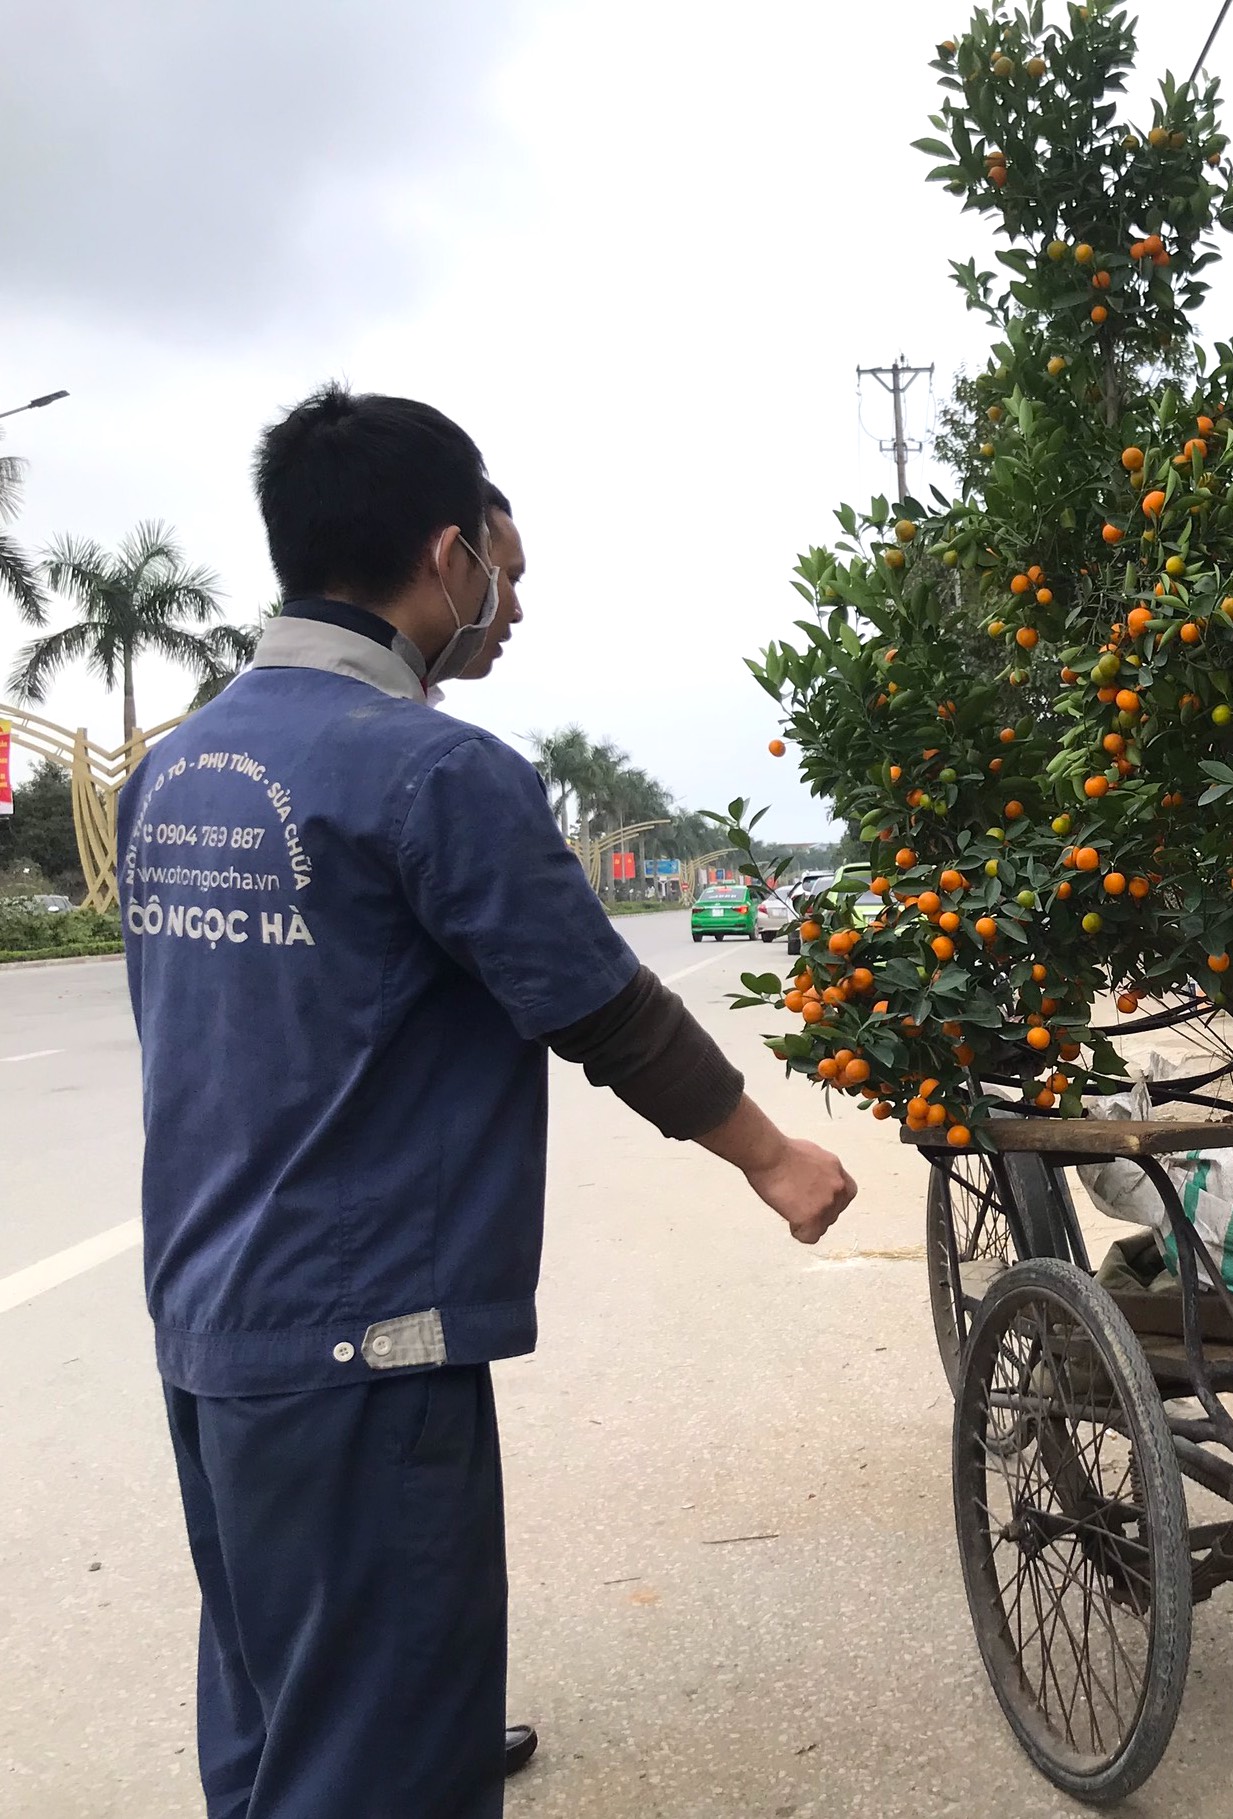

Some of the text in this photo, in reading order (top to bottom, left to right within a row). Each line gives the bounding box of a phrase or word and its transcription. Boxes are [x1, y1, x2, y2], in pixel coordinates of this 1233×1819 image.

[197, 752, 229, 773] PHỤ
[230, 752, 266, 782] TÙNG
[156, 823, 197, 846] 0904
[230, 828, 266, 850] 887
[166, 904, 250, 950] NGỌC
[260, 904, 316, 946] HÀ
